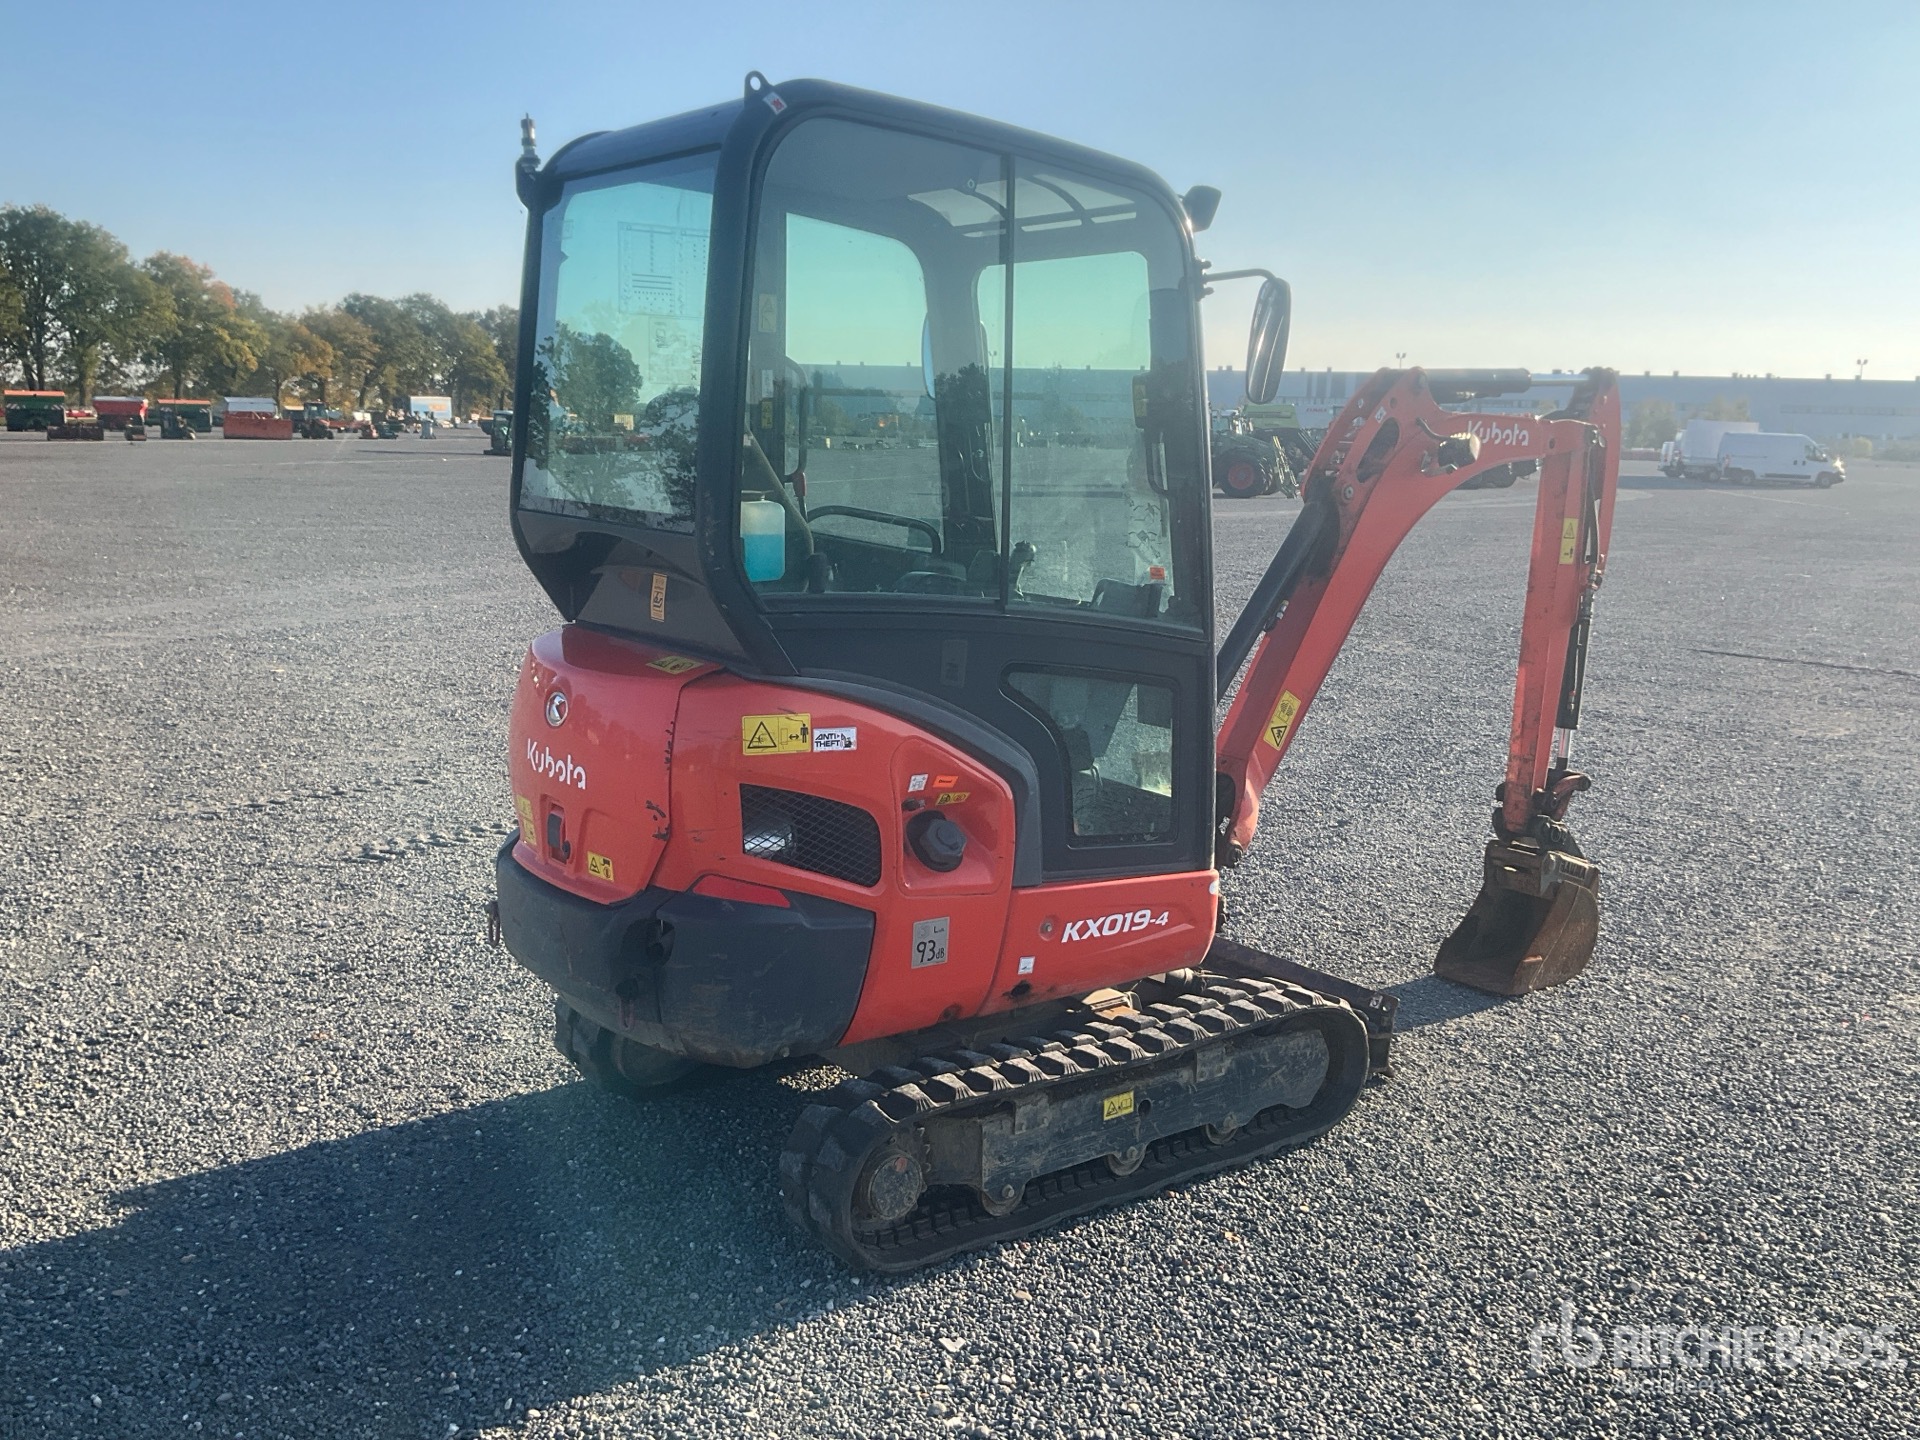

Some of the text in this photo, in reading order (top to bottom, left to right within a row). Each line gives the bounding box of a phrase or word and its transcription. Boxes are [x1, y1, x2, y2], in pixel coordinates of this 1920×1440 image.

[1467, 420, 1529, 446] Kubota
[527, 738, 586, 790] Kubota
[1061, 909, 1169, 943] KX019-4
